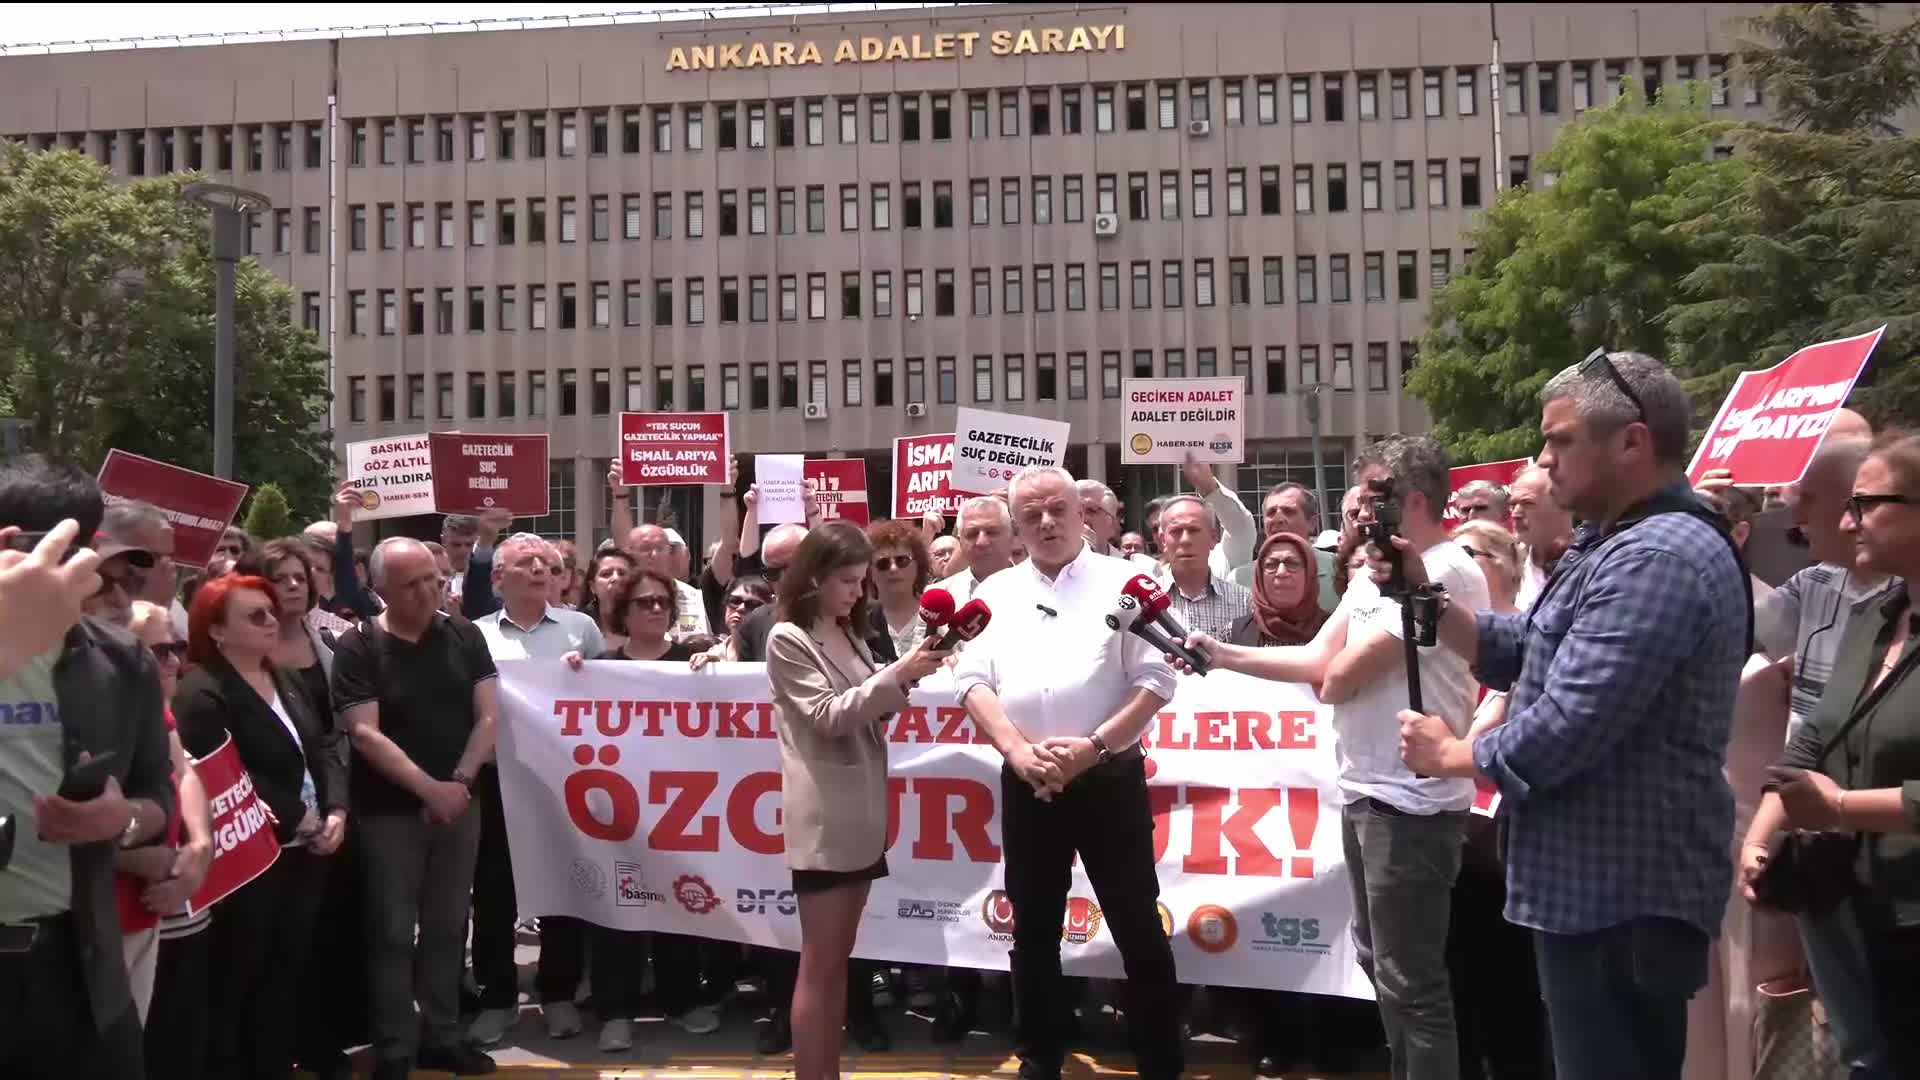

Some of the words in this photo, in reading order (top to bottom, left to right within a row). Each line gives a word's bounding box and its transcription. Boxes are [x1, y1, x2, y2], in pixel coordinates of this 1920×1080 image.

[665, 41, 822, 71] ANKARA
[834, 32, 979, 63] ADALET
[991, 24, 1126, 56] SARAYI
[1131, 389, 1184, 403] GECİKEN
[1187, 390, 1233, 402] ADALET
[1131, 411, 1176, 422] ADALET
[1180, 408, 1236, 421] DEĞİLDİR
[670, 423, 700, 433] SUÇUM
[624, 432, 680, 441] GAZETECİLİK
[968, 430, 1055, 453] GAZETECİLİK
[462, 443, 513, 456] GAZETECİLİK
[1157, 440, 1205, 448] HABER-SEN
[631, 449, 673, 462] İSMAİL
[676, 451, 717, 462] ARI'YA
[907, 442, 954, 467] İSMA
[961, 447, 986, 462] SUÇ
[364, 460, 389, 471] GÖZ
[393, 456, 431, 469] ALTIL
[641, 464, 708, 477] ÖZGÜRLÜK
[354, 475, 378, 488] BİZİ
[382, 472, 432, 486] YILDIRA
[384, 492, 429, 501] HABER-SEN
[554, 700, 777, 738] TUTUKL
[1262, 912, 1320, 945] tgs
